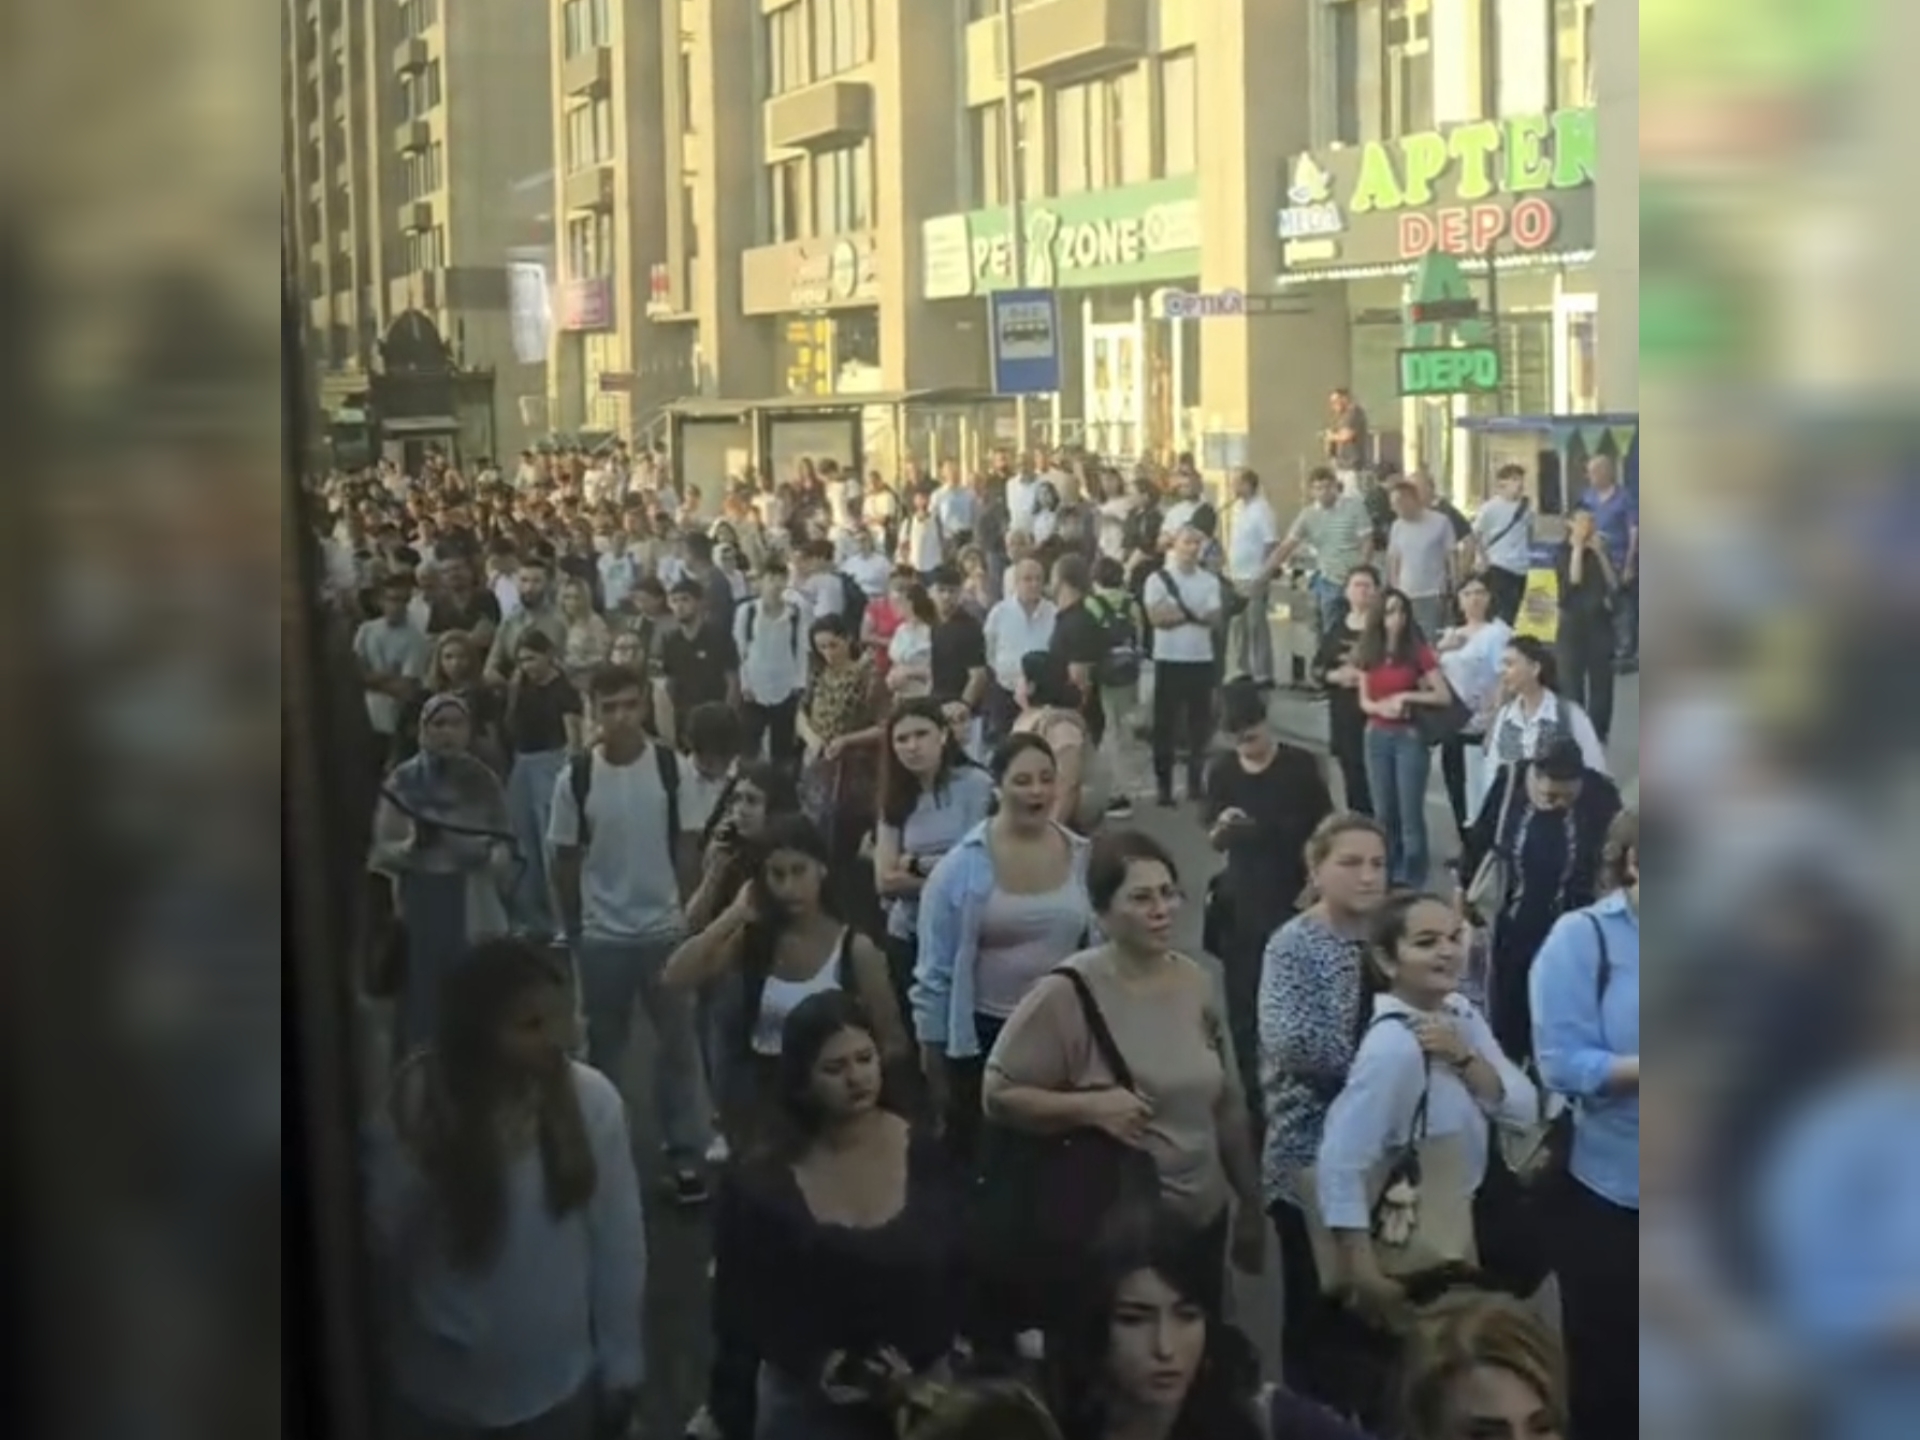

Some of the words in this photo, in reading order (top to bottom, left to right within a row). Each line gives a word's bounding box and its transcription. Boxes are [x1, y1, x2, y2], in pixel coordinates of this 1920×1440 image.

[1058, 219, 1142, 269] ZONE
[1399, 197, 1555, 258] DEPO
[1402, 350, 1498, 391] DEPO
